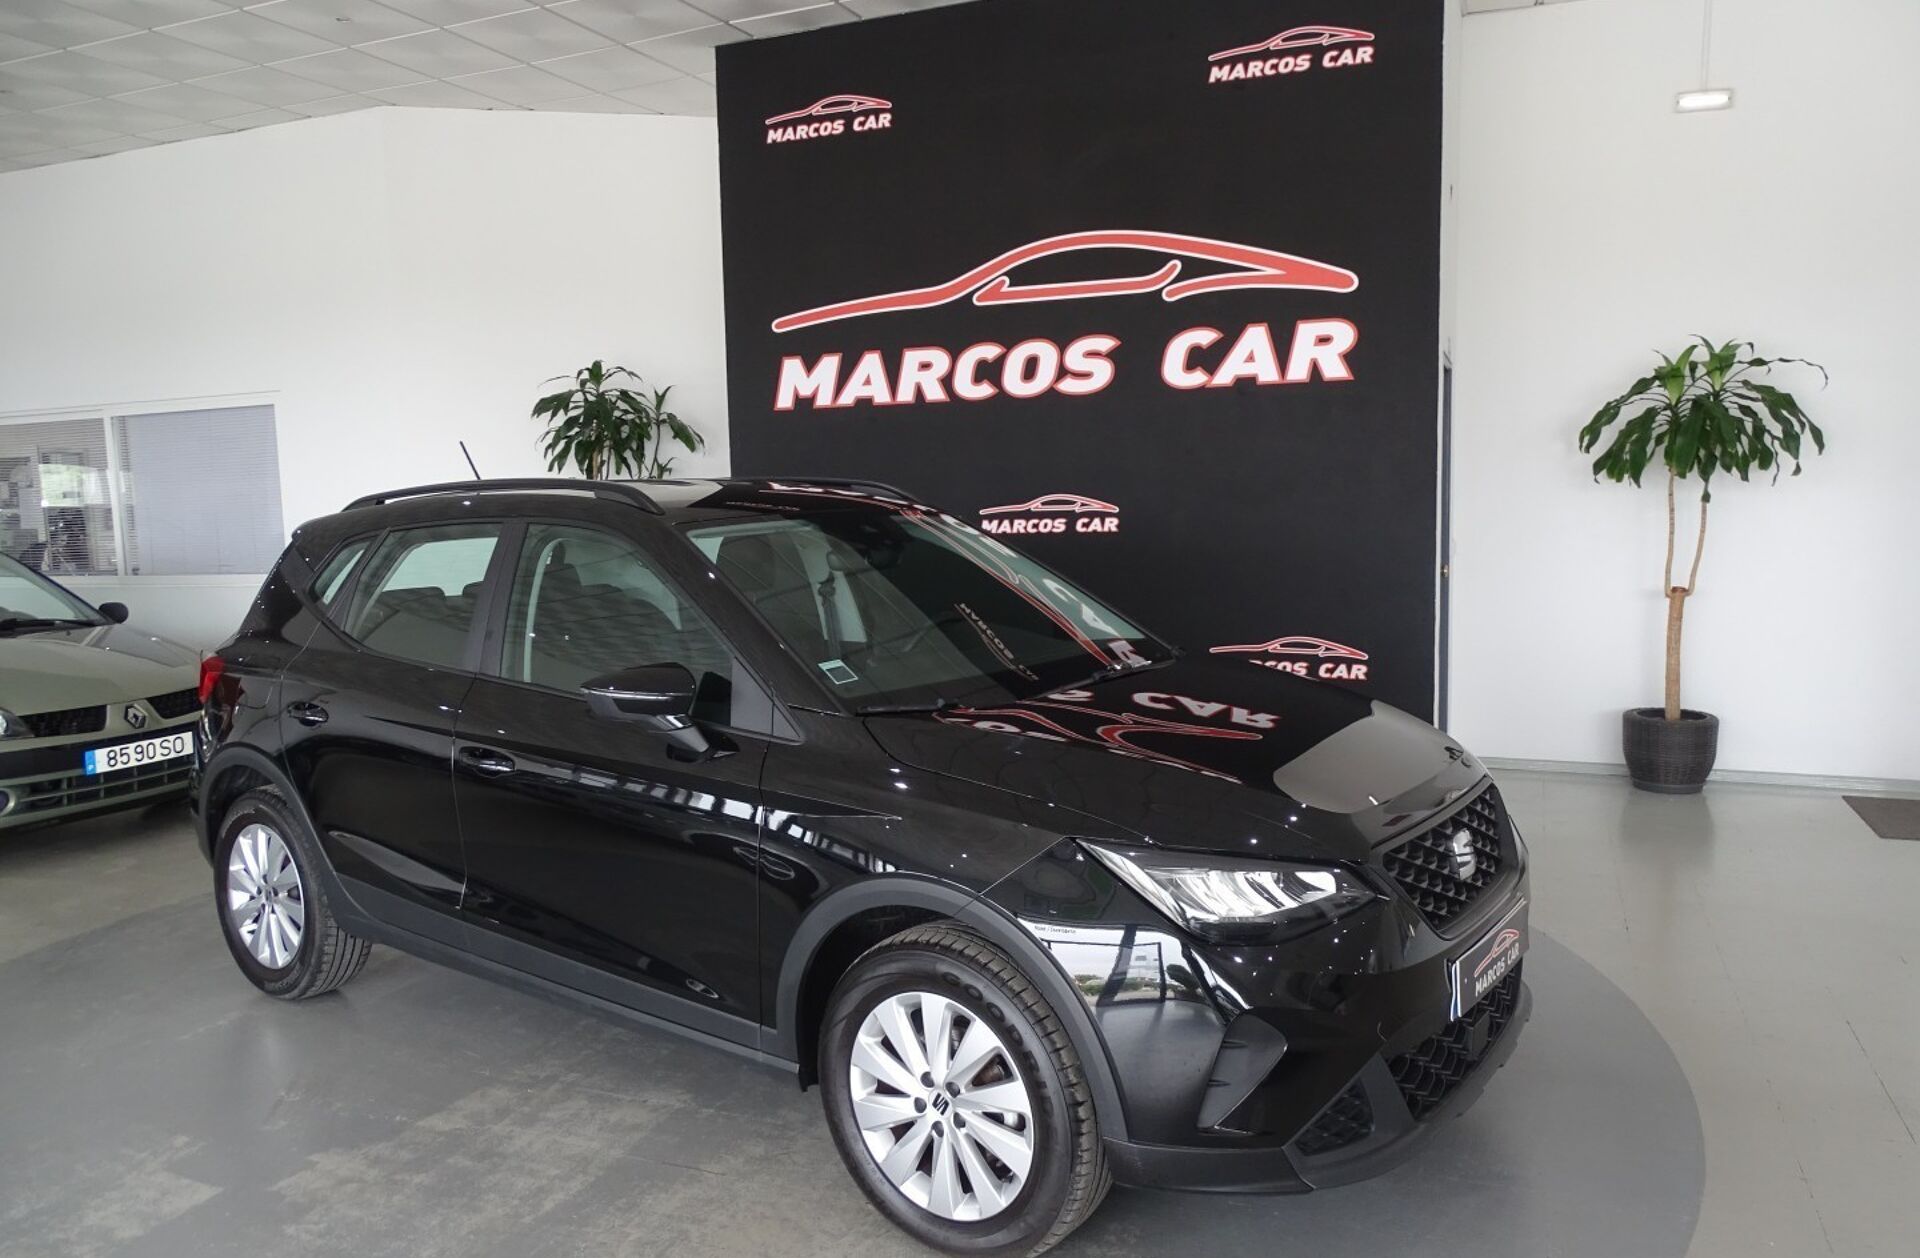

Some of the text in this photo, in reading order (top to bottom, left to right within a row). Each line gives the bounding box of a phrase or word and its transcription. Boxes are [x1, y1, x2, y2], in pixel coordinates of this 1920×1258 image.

[1208, 46, 1374, 83] MARCOS CAR
[766, 112, 892, 144] MARCOS CAR
[774, 318, 1358, 411] MARCOS CAR
[981, 517, 1120, 534] MARCOS CAR
[1318, 663, 1368, 681] CAR
[1475, 942, 1519, 997] MARCOS CAR
